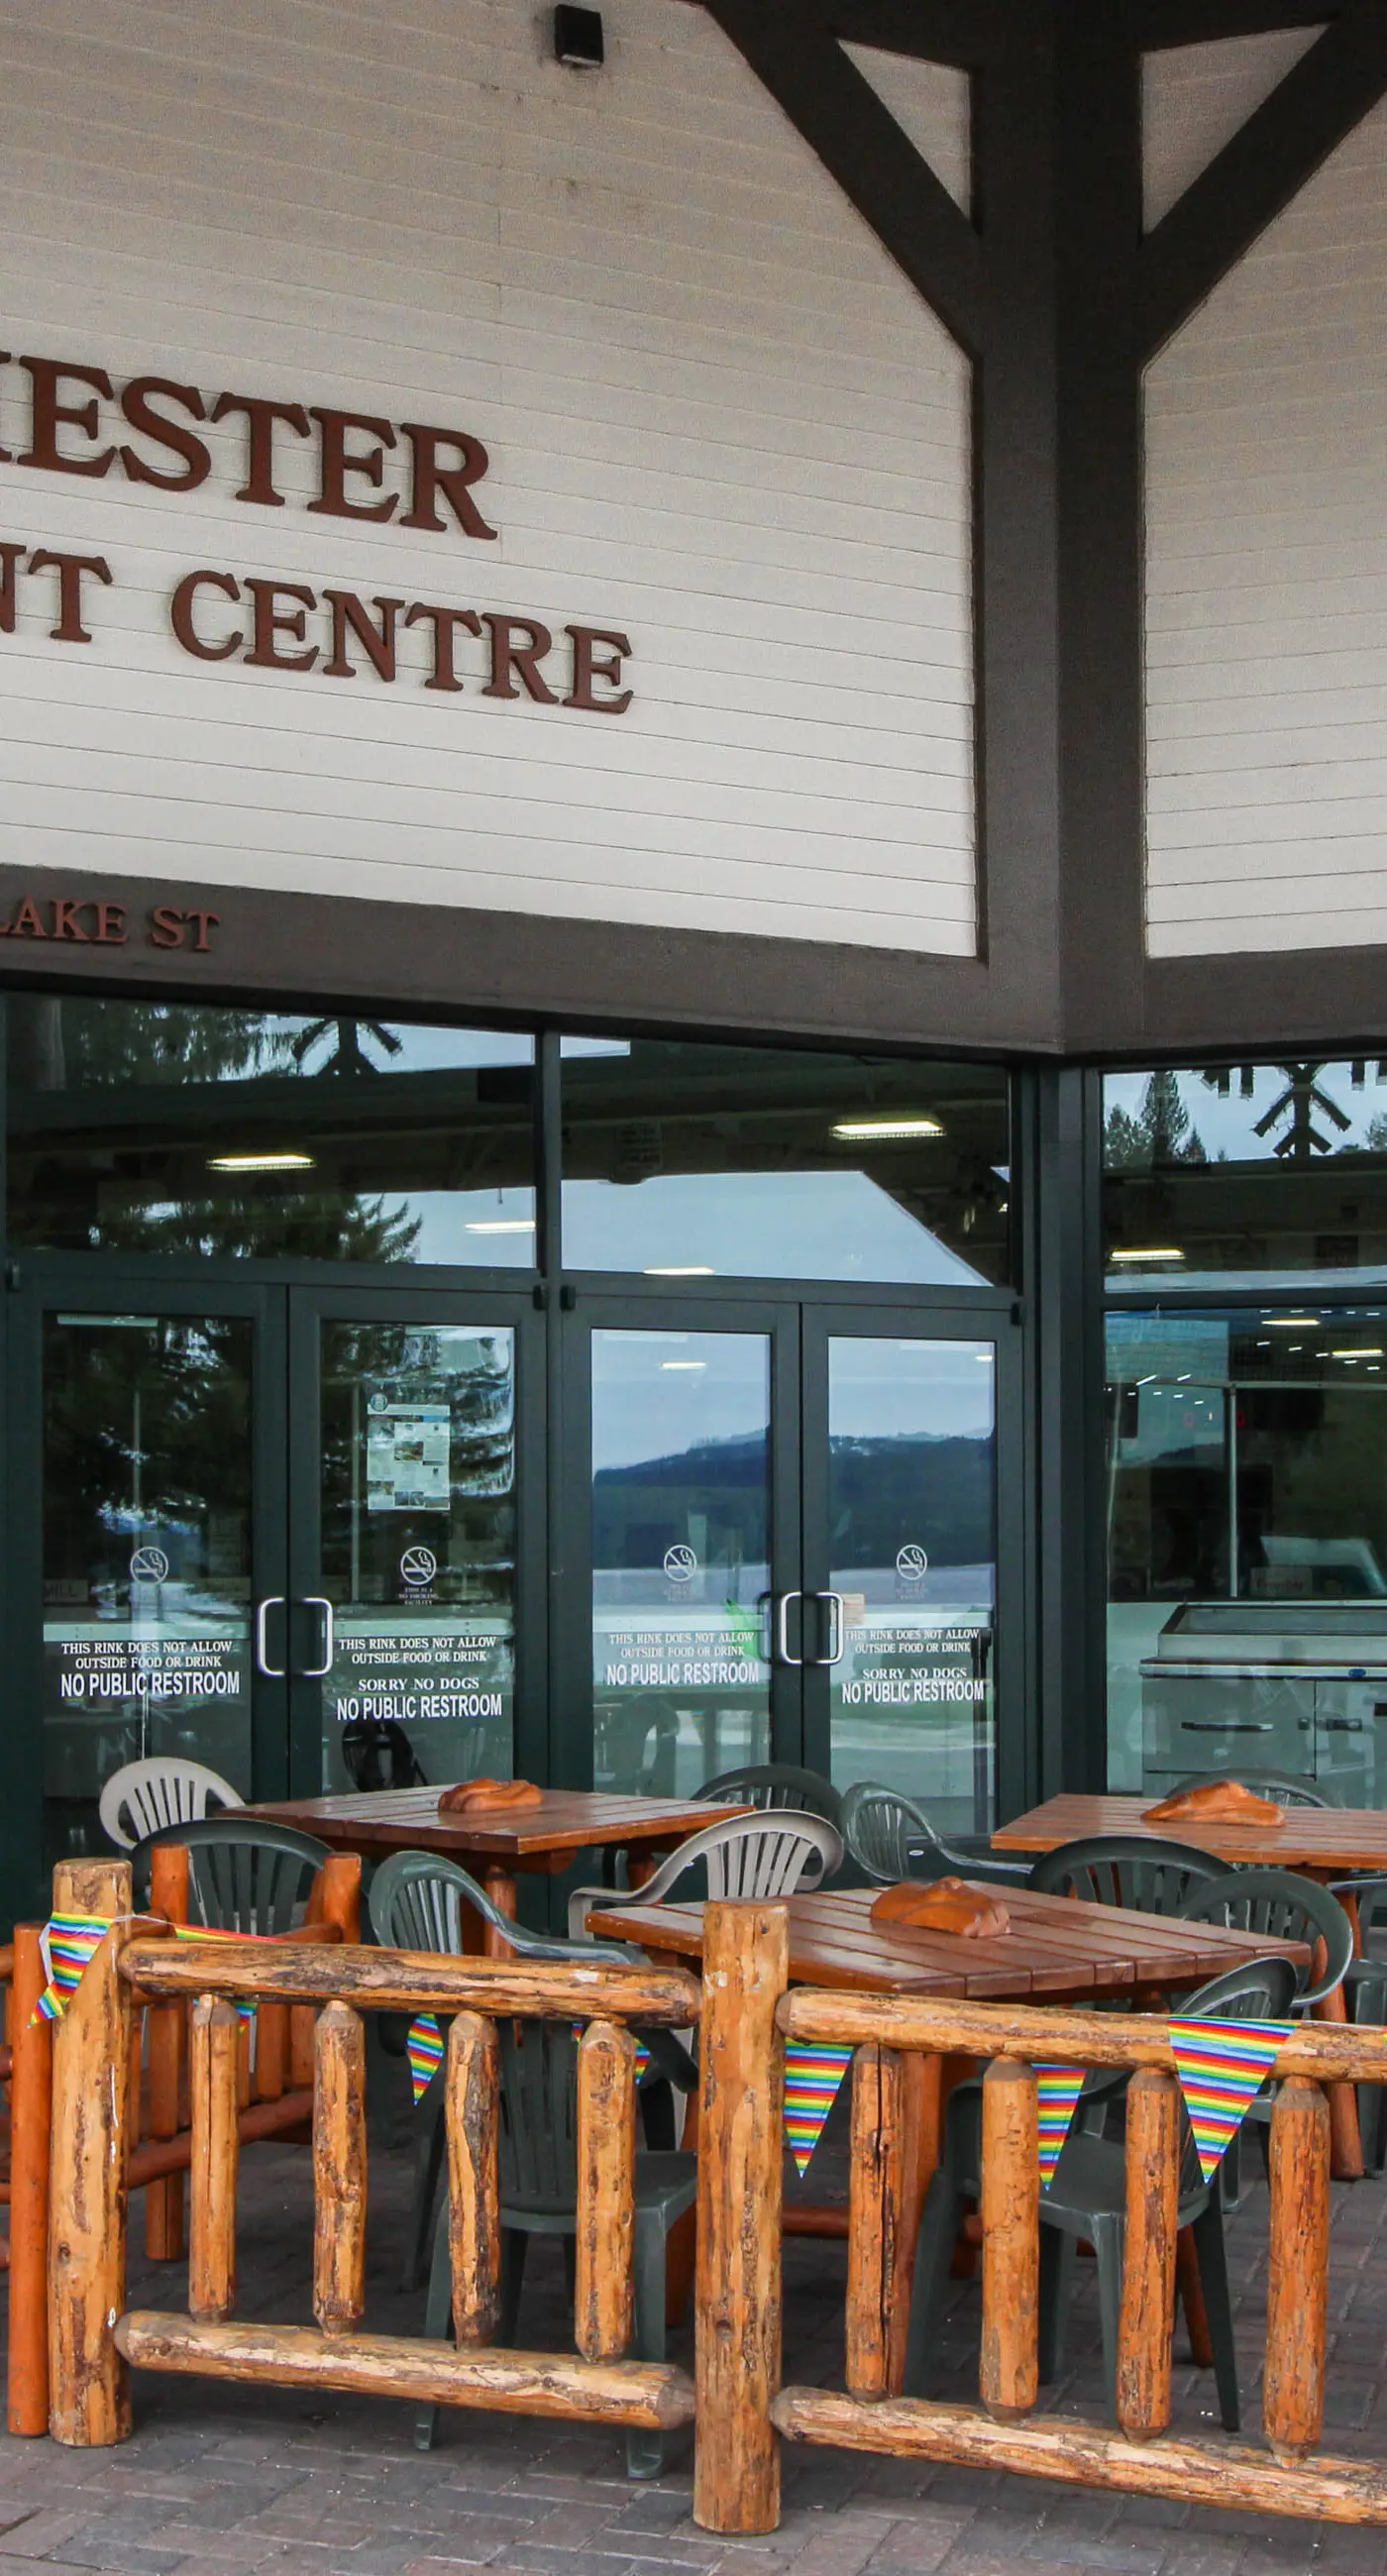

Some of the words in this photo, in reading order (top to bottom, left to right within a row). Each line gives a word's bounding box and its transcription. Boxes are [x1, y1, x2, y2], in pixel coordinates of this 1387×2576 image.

[0, 350, 498, 540] ESTER
[170, 569, 635, 714] CENTRE
[150, 906, 221, 952] ST
[608, 1634, 635, 1646] THIS
[636, 1633, 663, 1645] RINK
[665, 1632, 693, 1644] DOES
[694, 1632, 716, 1644] NOT
[718, 1632, 754, 1643] ALLOW
[844, 1630, 867, 1641] THIS
[870, 1630, 894, 1640] RINK
[896, 1629, 922, 1640] DOES
[923, 1629, 943, 1640] NOT
[945, 1628, 980, 1639] ALLOW
[61, 1643, 91, 1655] THIS
[94, 1643, 124, 1654] RINK
[128, 1642, 160, 1654] DOES
[162, 1642, 186, 1653] NOT
[191, 1641, 233, 1653] ALLOW
[339, 1639, 367, 1650] THIS
[369, 1638, 396, 1649] RINK
[400, 1638, 430, 1649] DOES
[432, 1637, 455, 1649] NOT
[458, 1637, 497, 1648] ALLOW
[855, 1643, 897, 1654] OUTSIDE
[899, 1643, 923, 1654] FOOD
[925, 1643, 939, 1653] OR
[941, 1641, 972, 1653] DRINK
[352, 1653, 400, 1664] OUTSIDE
[402, 1652, 432, 1664] FOOD
[435, 1652, 451, 1663] OR
[453, 1651, 487, 1663] DRINK
[620, 1647, 665, 1659] OUTSIDE
[668, 1647, 694, 1658] FOOD
[696, 1646, 711, 1657] OR
[713, 1646, 746, 1657] DRINK
[75, 1658, 127, 1669] OUTSIDE
[131, 1657, 162, 1668] FOOD
[165, 1657, 182, 1667] OR
[185, 1656, 223, 1667] DRINK
[606, 1664, 628, 1685] NO
[630, 1664, 681, 1685] PUBLIC
[683, 1662, 760, 1683] RESTROOM
[863, 1667, 906, 1680] SORRY
[910, 1667, 928, 1678] NO
[933, 1666, 968, 1678] DOGS
[60, 1673, 85, 1697] NO
[89, 1672, 147, 1696] PUBLIC
[151, 1670, 240, 1695] RESTROOM
[358, 1678, 408, 1691] SORRY
[413, 1678, 435, 1690] NO
[440, 1677, 480, 1690] DOGS
[842, 1683, 862, 1704] NO
[864, 1681, 910, 1703] PUBLIC
[913, 1679, 985, 1702] RESTROOM
[337, 1697, 360, 1721] NO
[363, 1696, 417, 1719] PUBLIC
[420, 1693, 502, 1718] RESTROOM
